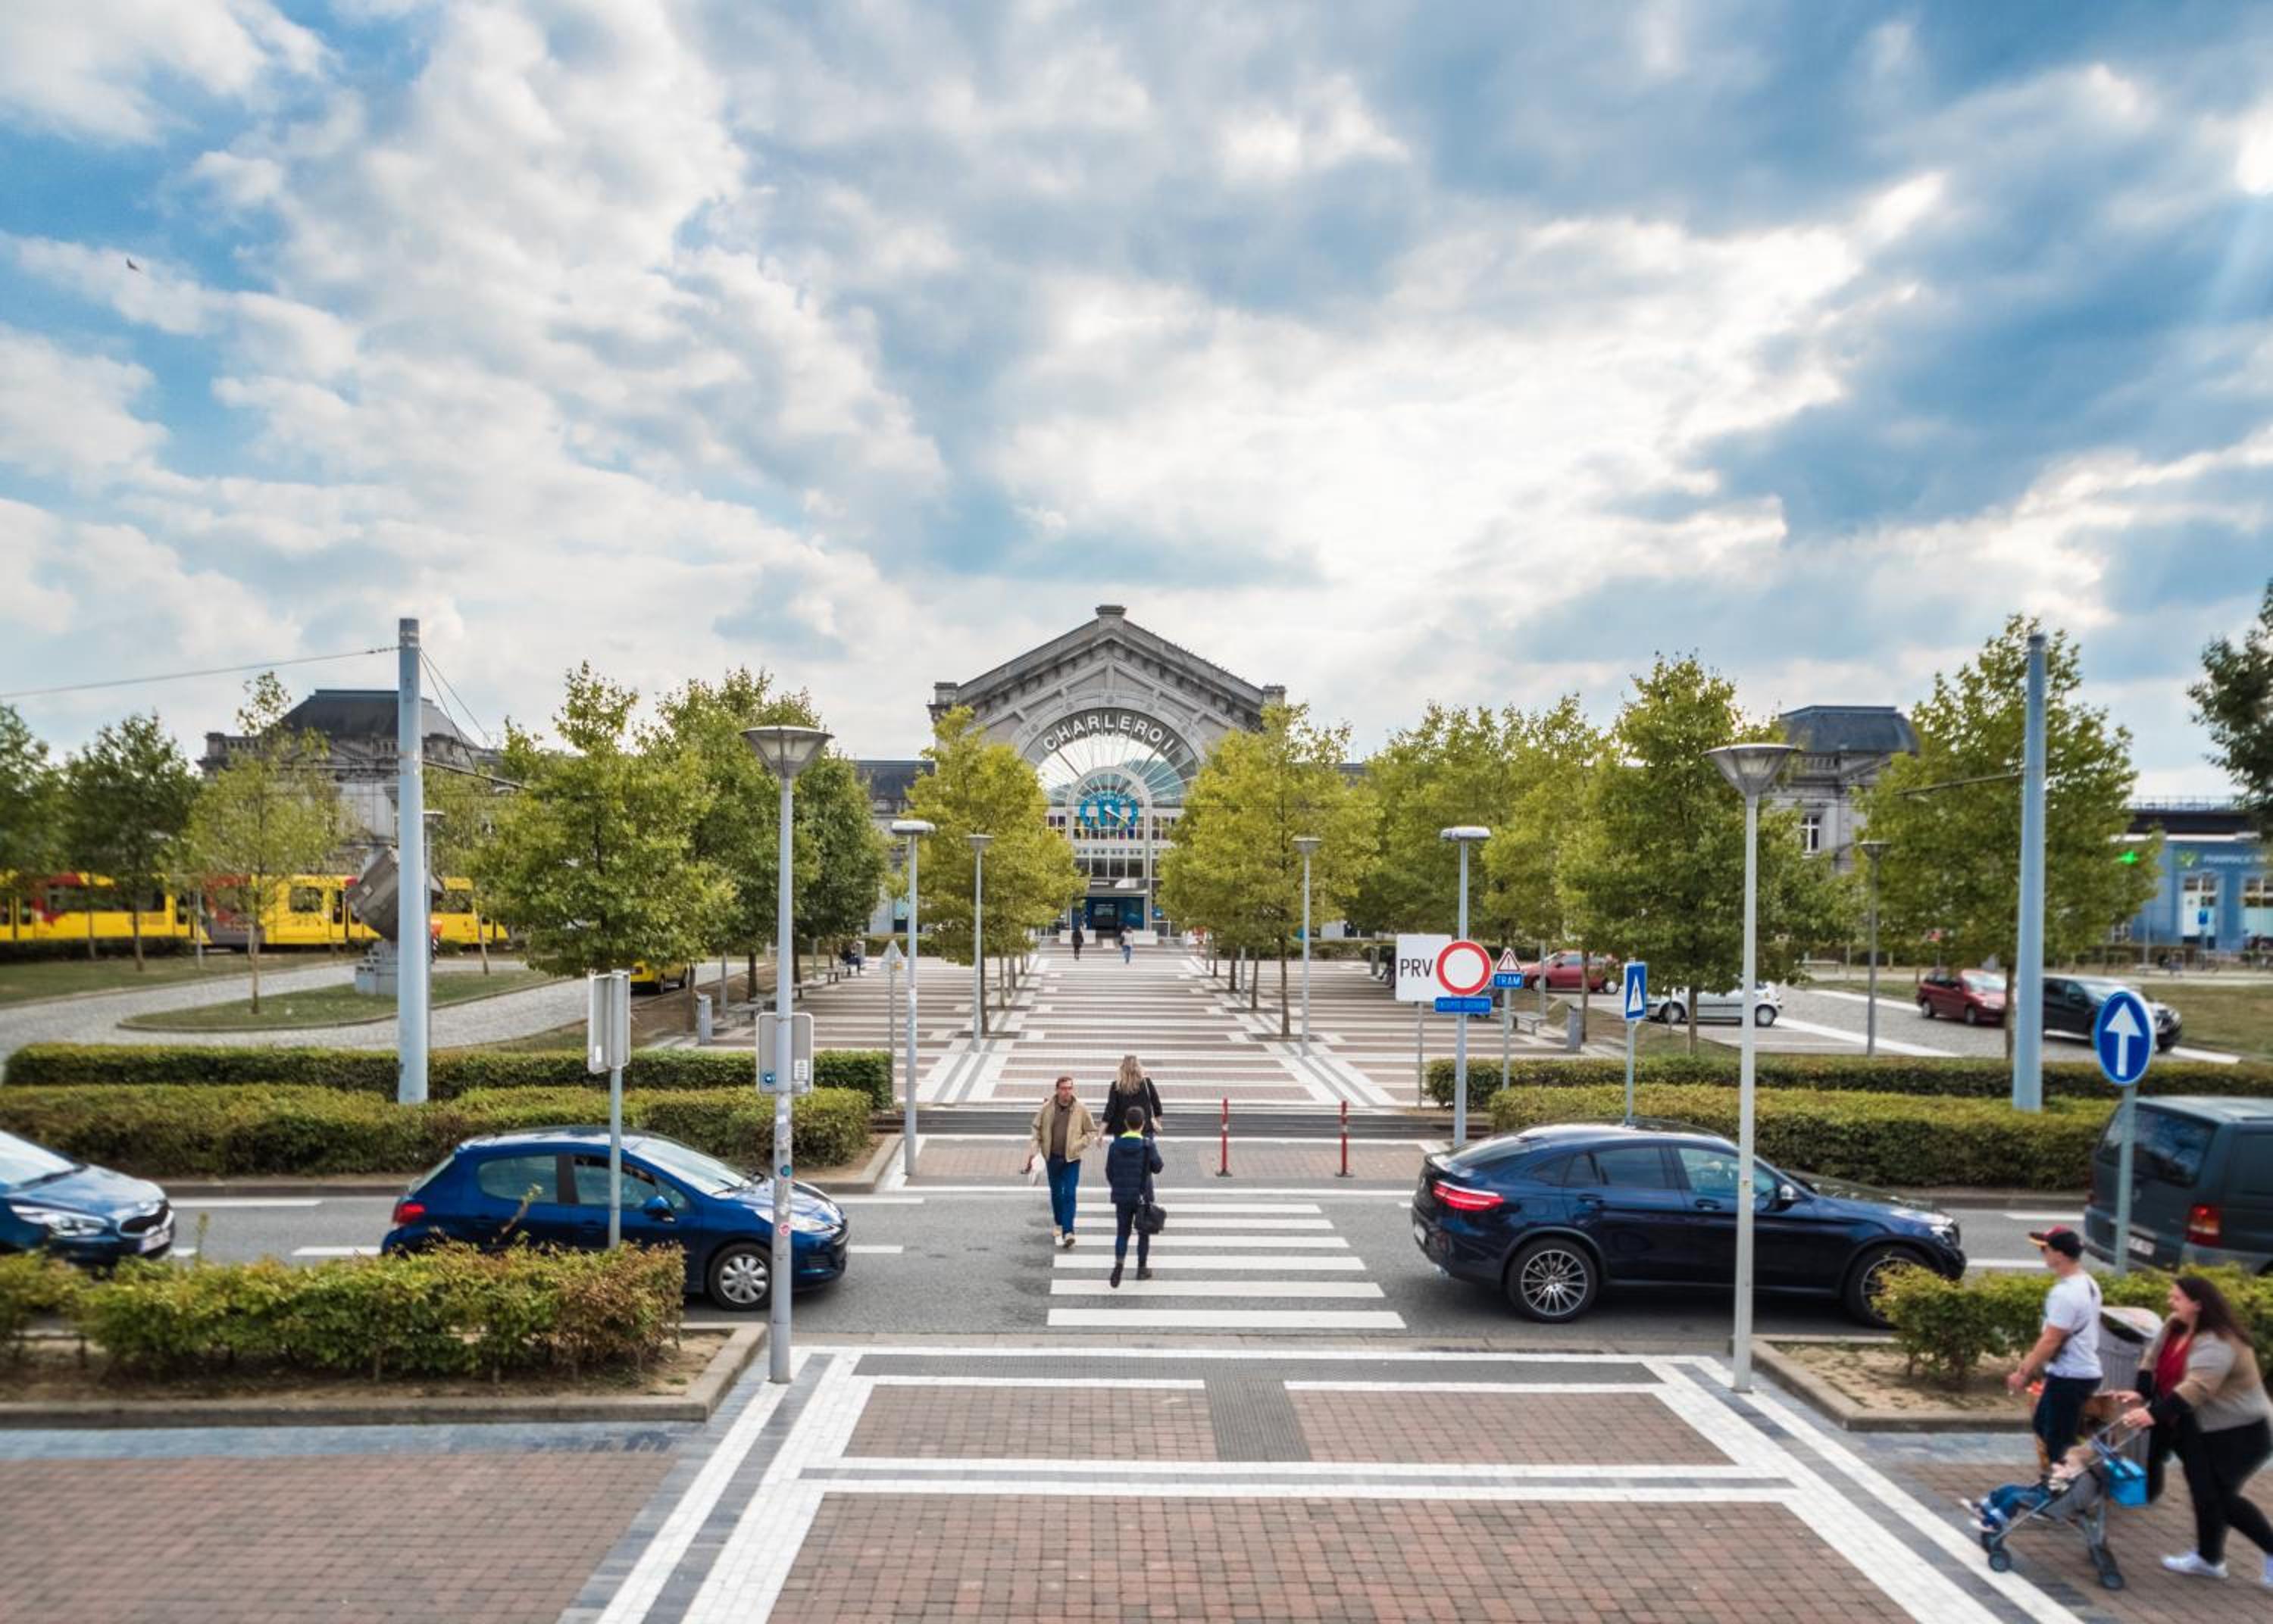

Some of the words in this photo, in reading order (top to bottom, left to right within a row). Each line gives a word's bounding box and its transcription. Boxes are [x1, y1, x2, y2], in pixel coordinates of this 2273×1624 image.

[1043, 715, 1174, 751] CHARLEROI
[1400, 958, 1433, 977] PRV
[1496, 975, 1521, 985] TRAM
